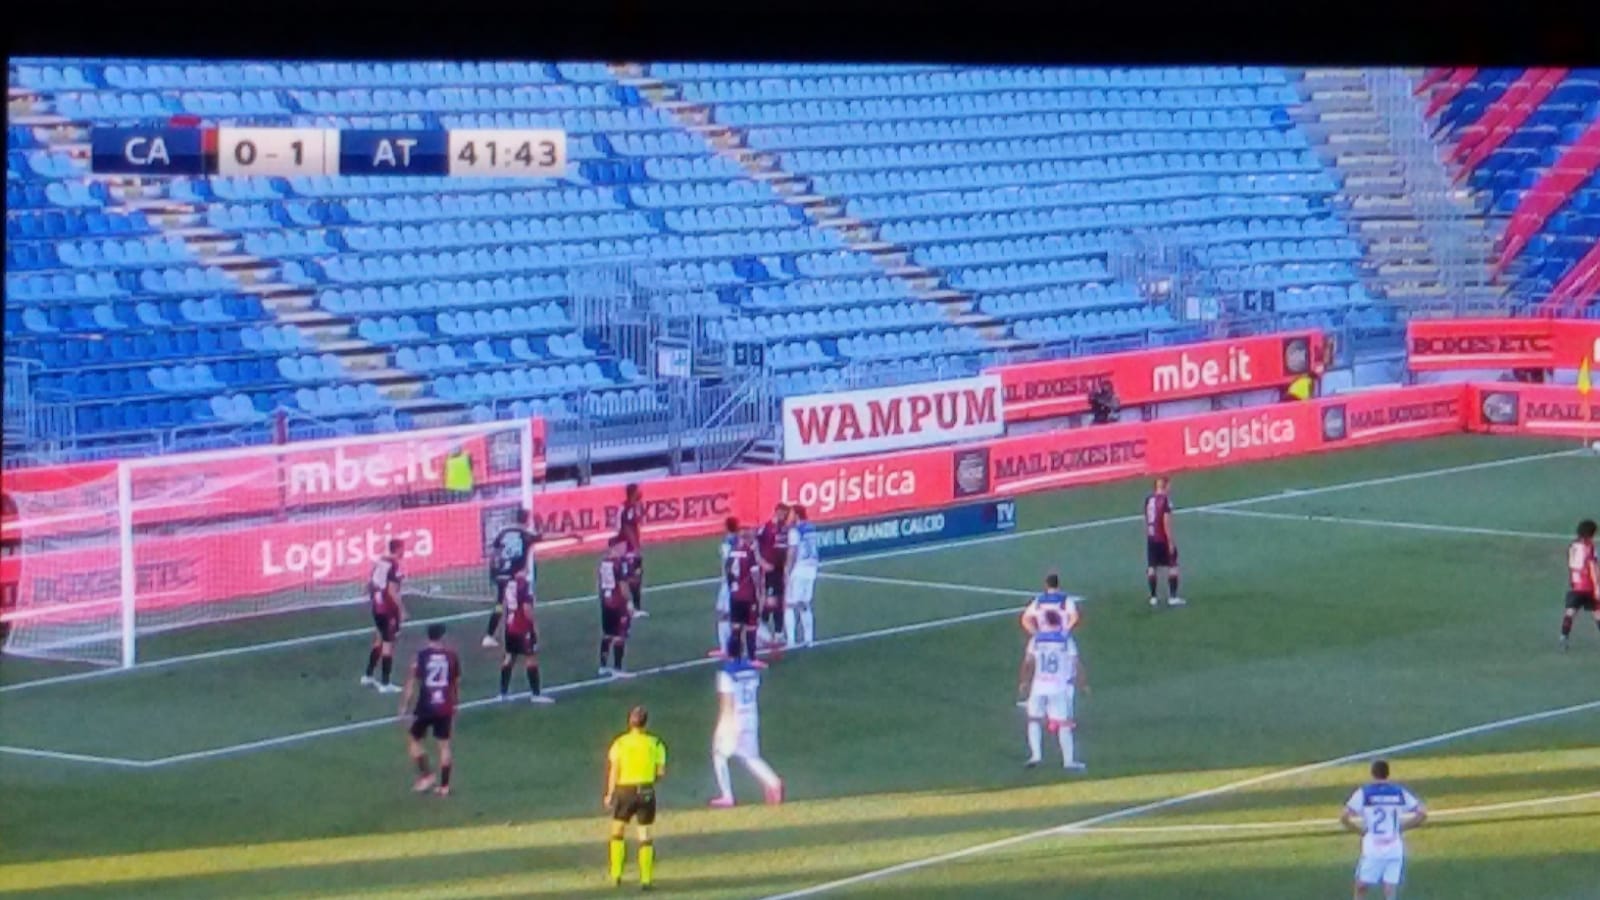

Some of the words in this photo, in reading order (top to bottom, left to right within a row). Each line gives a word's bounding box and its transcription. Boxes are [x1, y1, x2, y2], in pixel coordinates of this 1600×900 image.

[124, 137, 170, 165] CA
[372, 139, 418, 167] AT
[457, 140, 558, 167] 41:43
[1152, 346, 1251, 392] mbe.it
[792, 387, 997, 446] WAMPUM
[1525, 402, 1585, 421] MAIL
[1184, 413, 1295, 458] Logistica
[290, 441, 438, 495] mbe.it
[994, 453, 1047, 481] MAIL
[1049, 445, 1109, 472] BOXES
[1110, 440, 1147, 464] ETC
[781, 465, 917, 513] Logistica
[535, 509, 600, 534] MAIL
[604, 496, 681, 528] BXES
[683, 492, 732, 520] ETC
[849, 517, 900, 542] GRANDE
[901, 508, 946, 536] CALCIO
[1040, 651, 1059, 674] 18
[1372, 806, 1398, 835] 21
